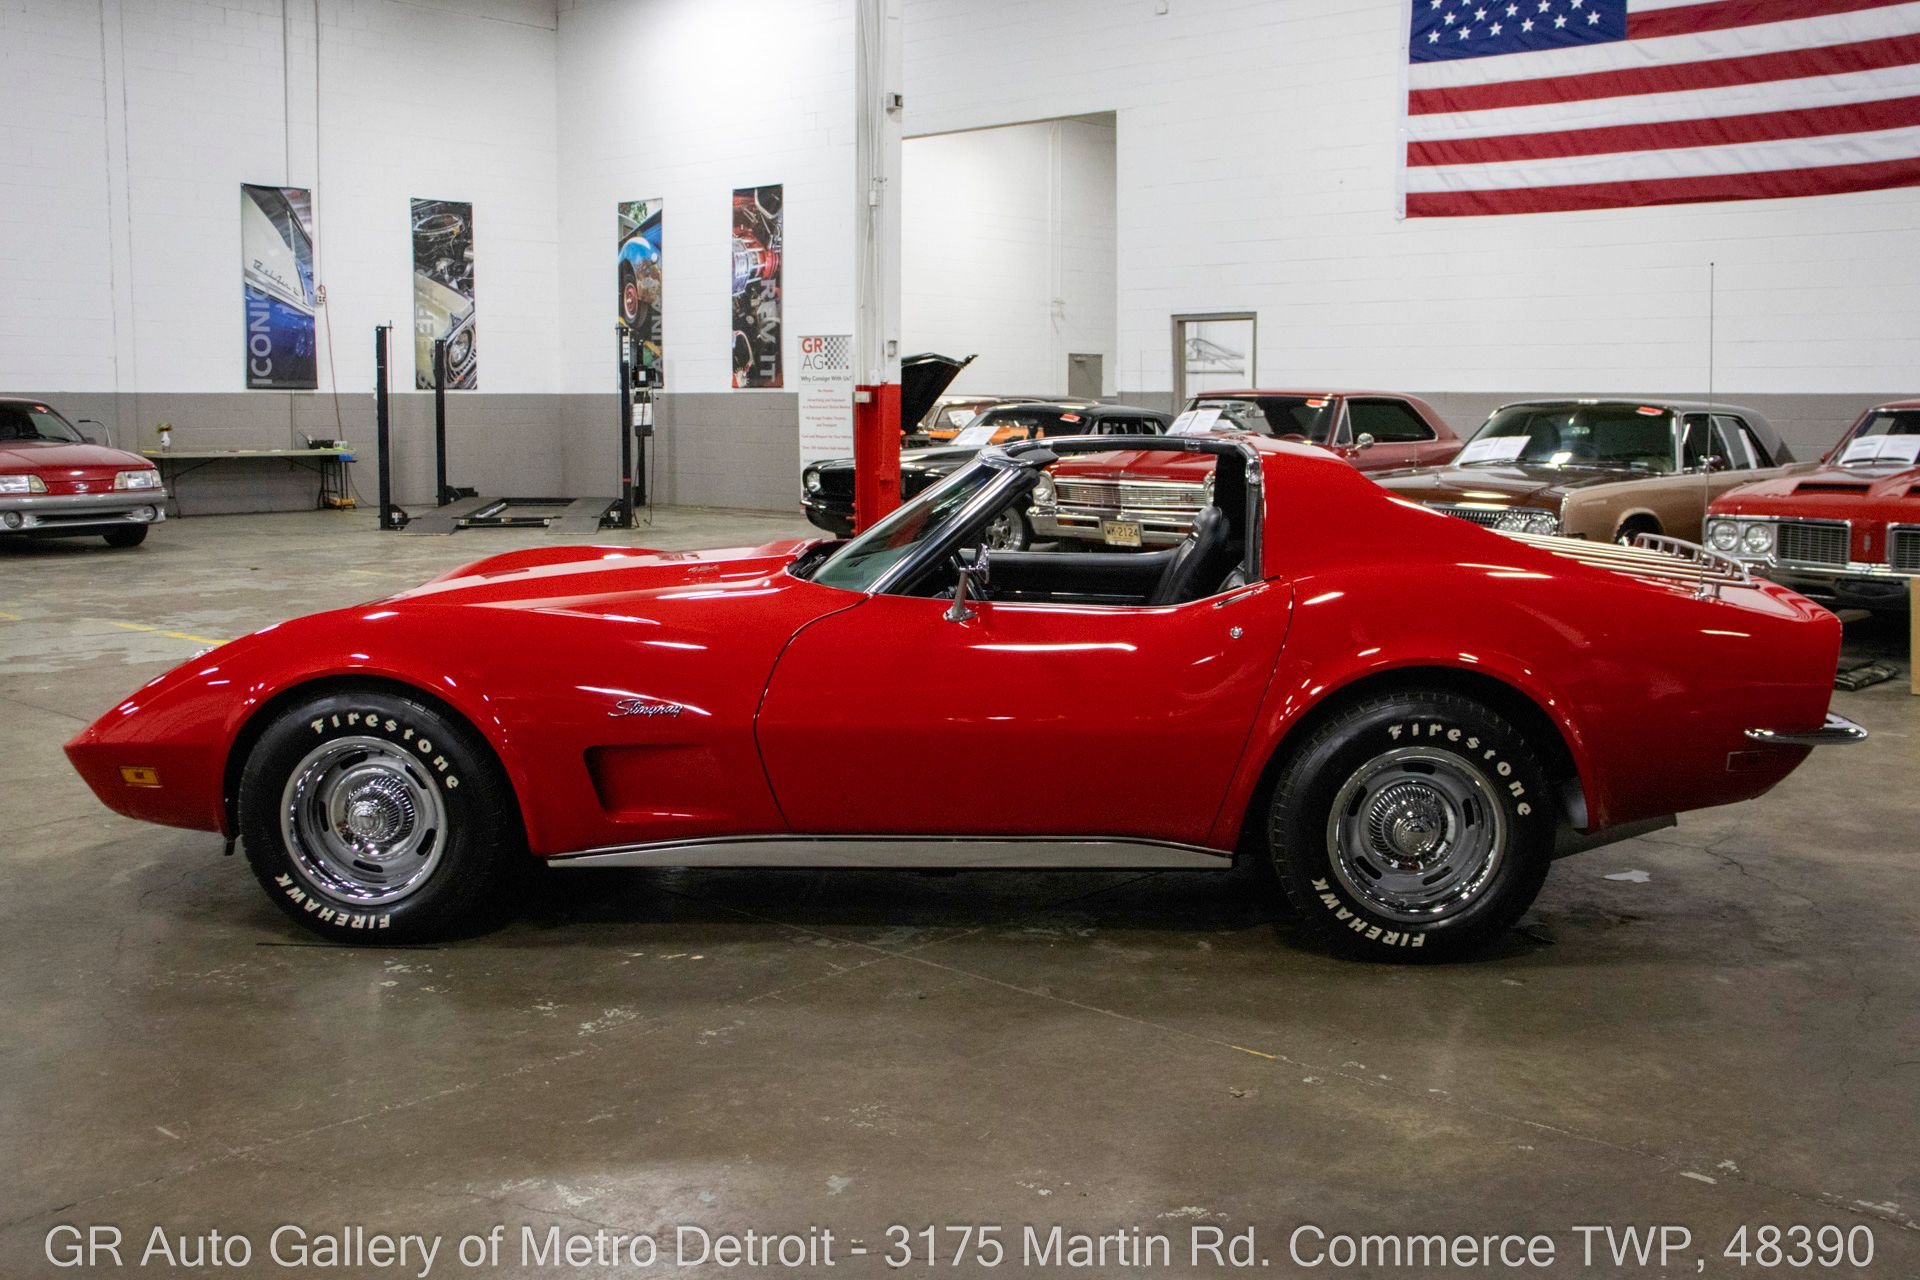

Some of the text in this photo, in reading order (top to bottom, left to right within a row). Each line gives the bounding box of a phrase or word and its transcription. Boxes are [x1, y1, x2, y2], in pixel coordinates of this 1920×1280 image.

[758, 279, 777, 382] REV IT
[802, 338, 823, 354] GR
[801, 375, 812, 383] Why
[812, 375, 830, 383] Consign
[831, 374, 842, 382] With
[802, 354, 824, 370] AG
[608, 698, 684, 718] Stingray
[310, 712, 459, 789] Firestone
[1388, 723, 1532, 817] Firestone
[274, 872, 392, 930] FIREHAWK
[1311, 877, 1427, 948] FIREHAWK
